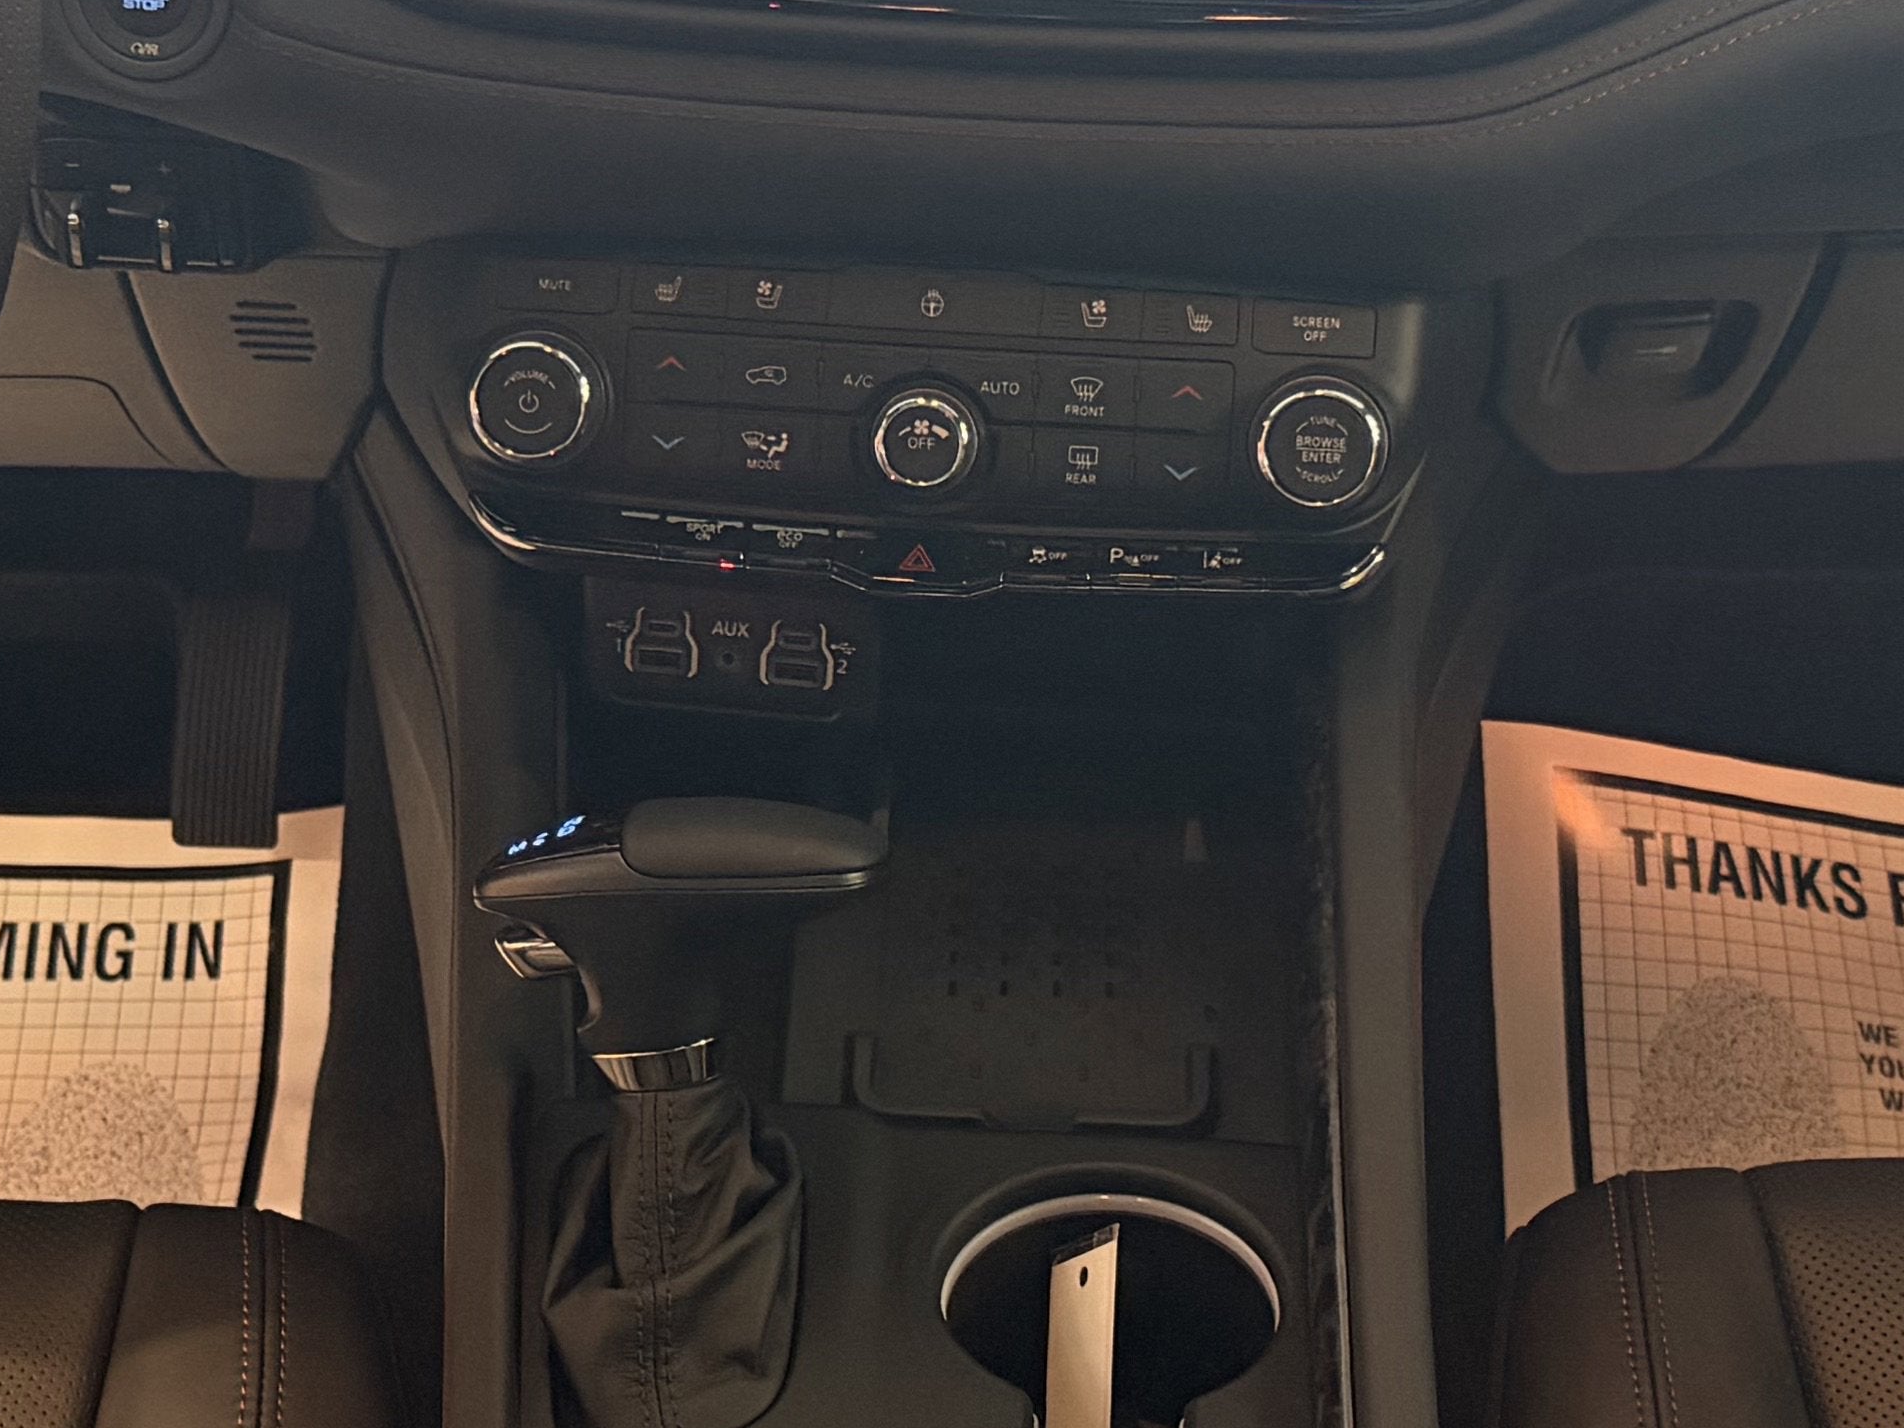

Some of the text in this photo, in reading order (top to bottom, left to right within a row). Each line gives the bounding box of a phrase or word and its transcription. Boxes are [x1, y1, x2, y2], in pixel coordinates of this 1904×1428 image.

[539, 279, 572, 291] MUTE
[1292, 315, 1341, 330] SCREEN
[1303, 330, 1327, 342] OFF
[843, 373, 874, 389] A/C
[980, 380, 1021, 396] AUTO
[1064, 404, 1105, 417] FRONT
[1310, 416, 1338, 429] TUNE
[907, 437, 936, 451] OFF
[1296, 434, 1346, 449] BROWSE
[1301, 450, 1342, 464] ENTER
[747, 458, 782, 471] MODE
[1064, 472, 1097, 485] REAR
[1300, 469, 1340, 484] SCROLL
[686, 523, 725, 535] SPORT
[1047, 551, 1068, 561] OFF
[712, 620, 750, 637] AUX
[836, 659, 848, 674] 2
[1621, 827, 1869, 922] THANKS
[161, 918, 228, 986] IN
[1857, 1019, 1901, 1053] WE
